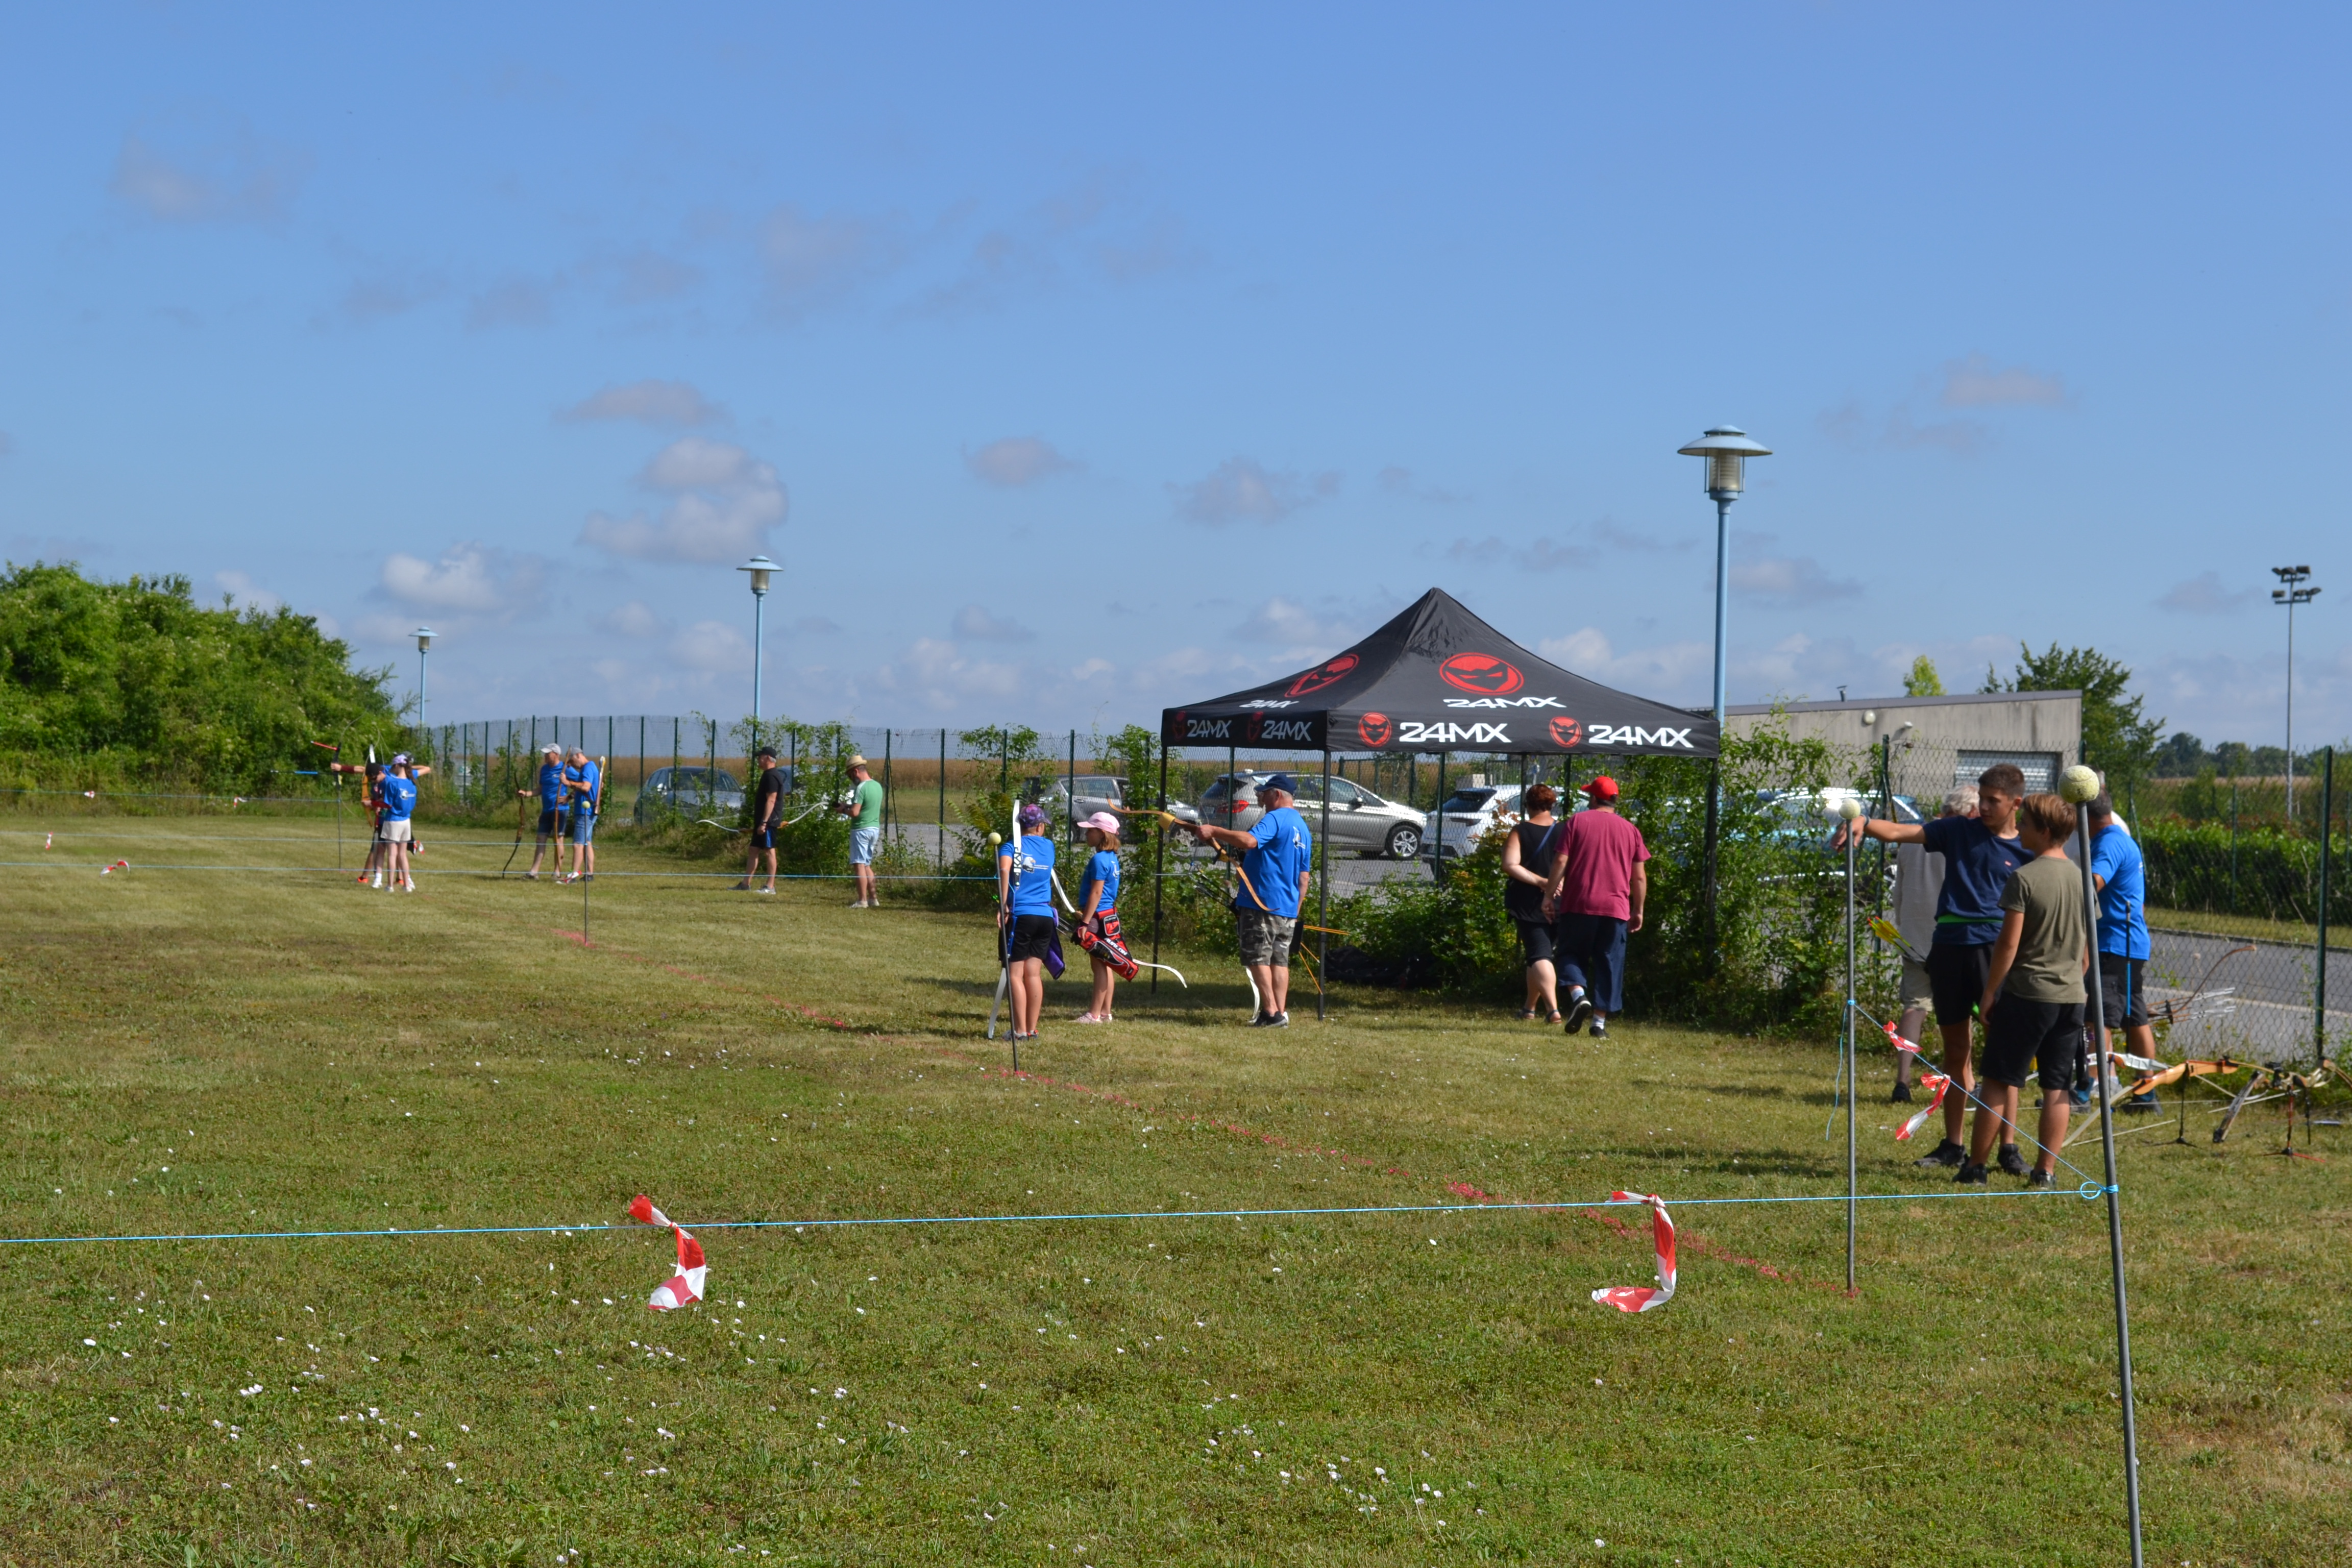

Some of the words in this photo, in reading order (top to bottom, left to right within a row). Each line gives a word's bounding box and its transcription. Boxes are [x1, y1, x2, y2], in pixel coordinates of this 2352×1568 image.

[1239, 700, 1299, 708] 24MX
[1443, 697, 1567, 708] 24MX
[1187, 720, 1232, 738] 24MX
[1261, 720, 1312, 741] 24MX
[1399, 722, 1512, 743] 24MX
[1588, 725, 1694, 748] 24MX
[1104, 938, 1128, 955] AVALON
